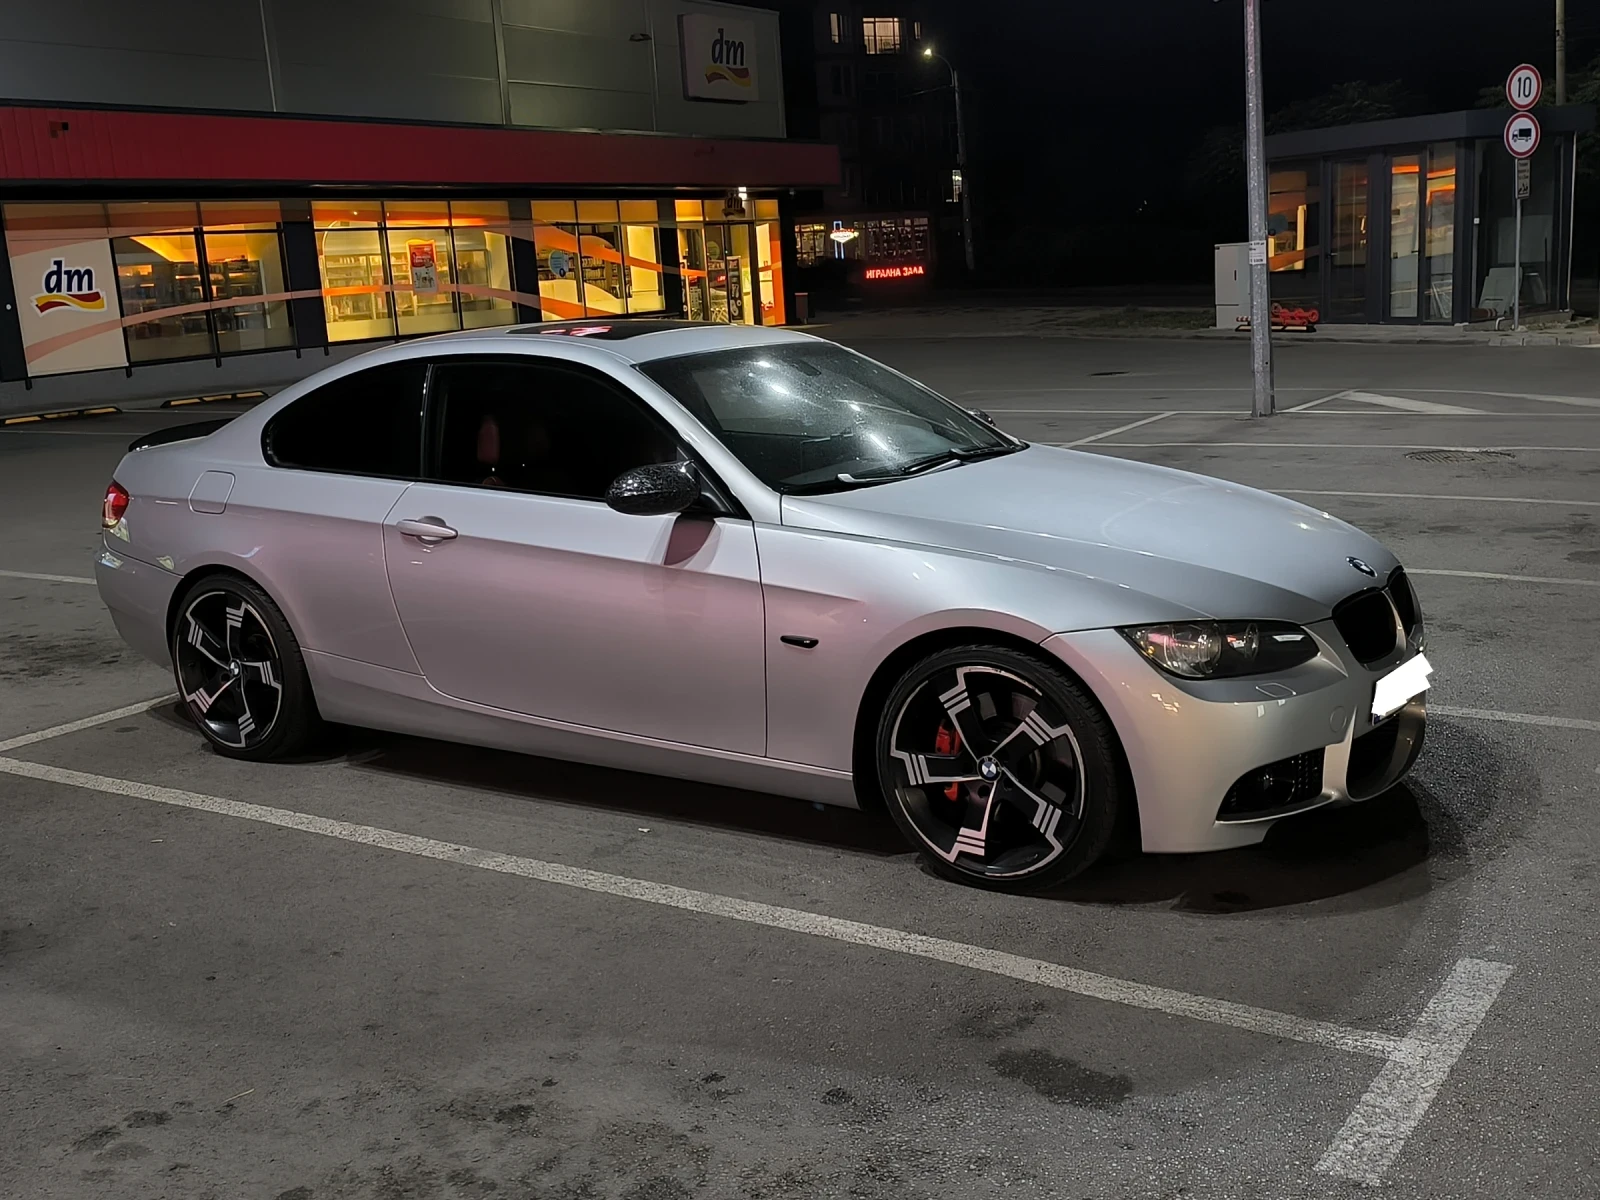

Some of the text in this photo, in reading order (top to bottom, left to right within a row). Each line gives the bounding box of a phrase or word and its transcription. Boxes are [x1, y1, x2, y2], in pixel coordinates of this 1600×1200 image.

[711, 27, 745, 67] dm
[1517, 76, 1532, 98] 10
[44, 259, 94, 294] dm
[865, 265, 924, 279] ИГРАЛНА ЗАЛА
